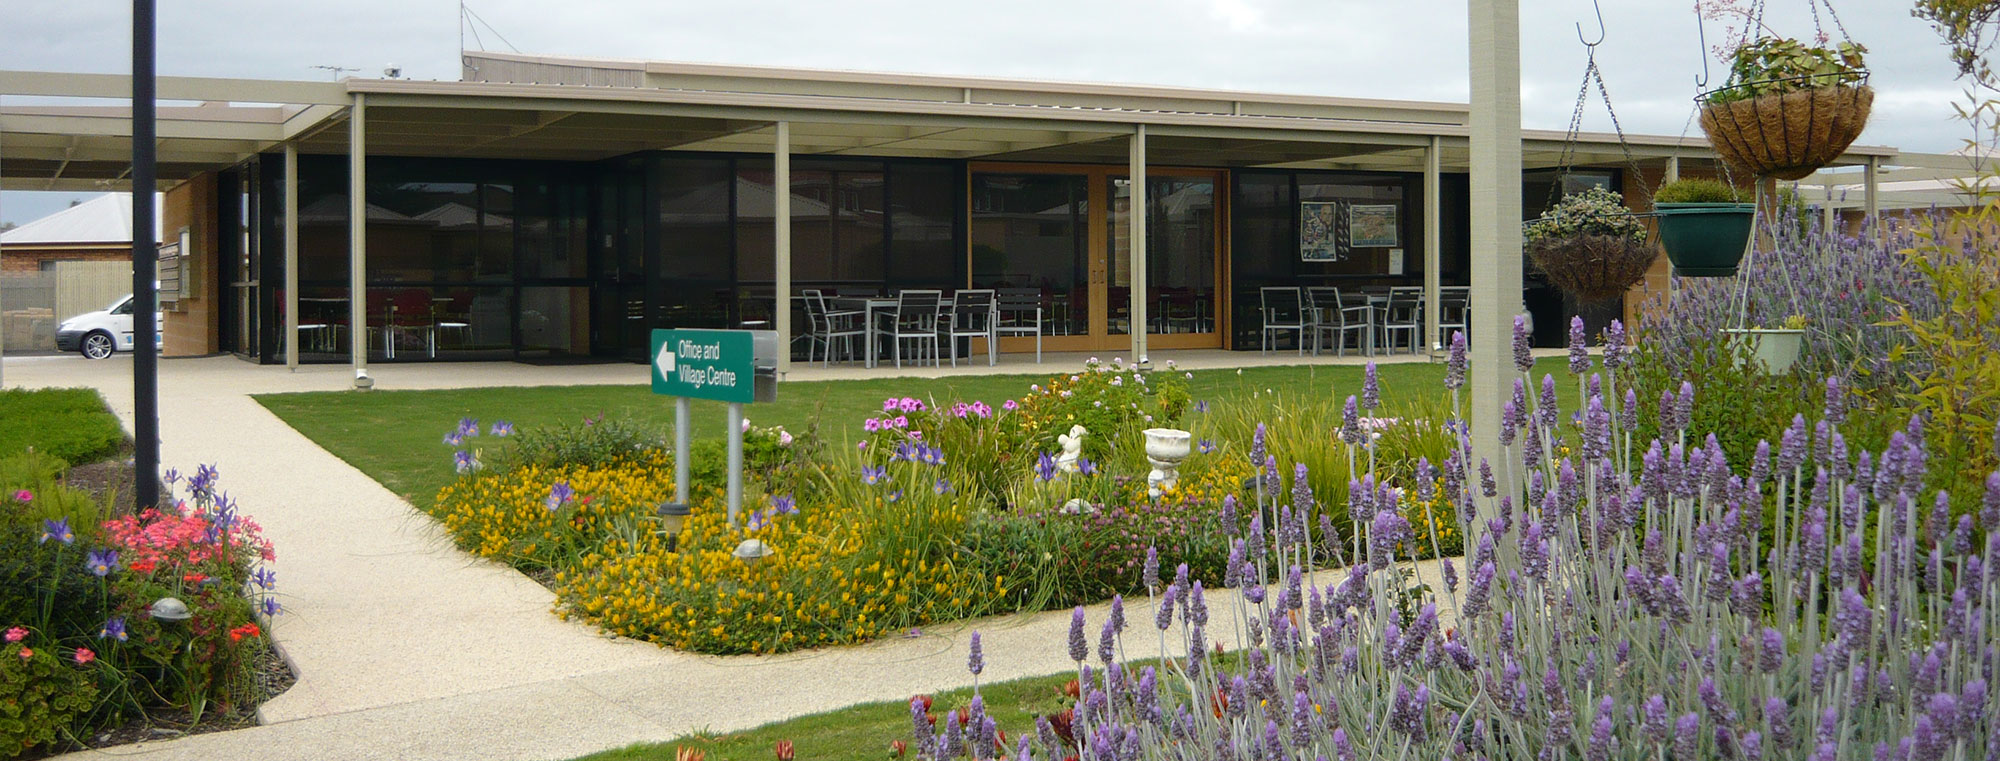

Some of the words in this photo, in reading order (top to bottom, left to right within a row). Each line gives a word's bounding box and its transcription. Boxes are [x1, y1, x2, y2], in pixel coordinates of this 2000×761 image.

[679, 340, 702, 359] Office
[704, 341, 720, 360] and
[679, 364, 705, 388] Village
[707, 365, 736, 387] Centre
